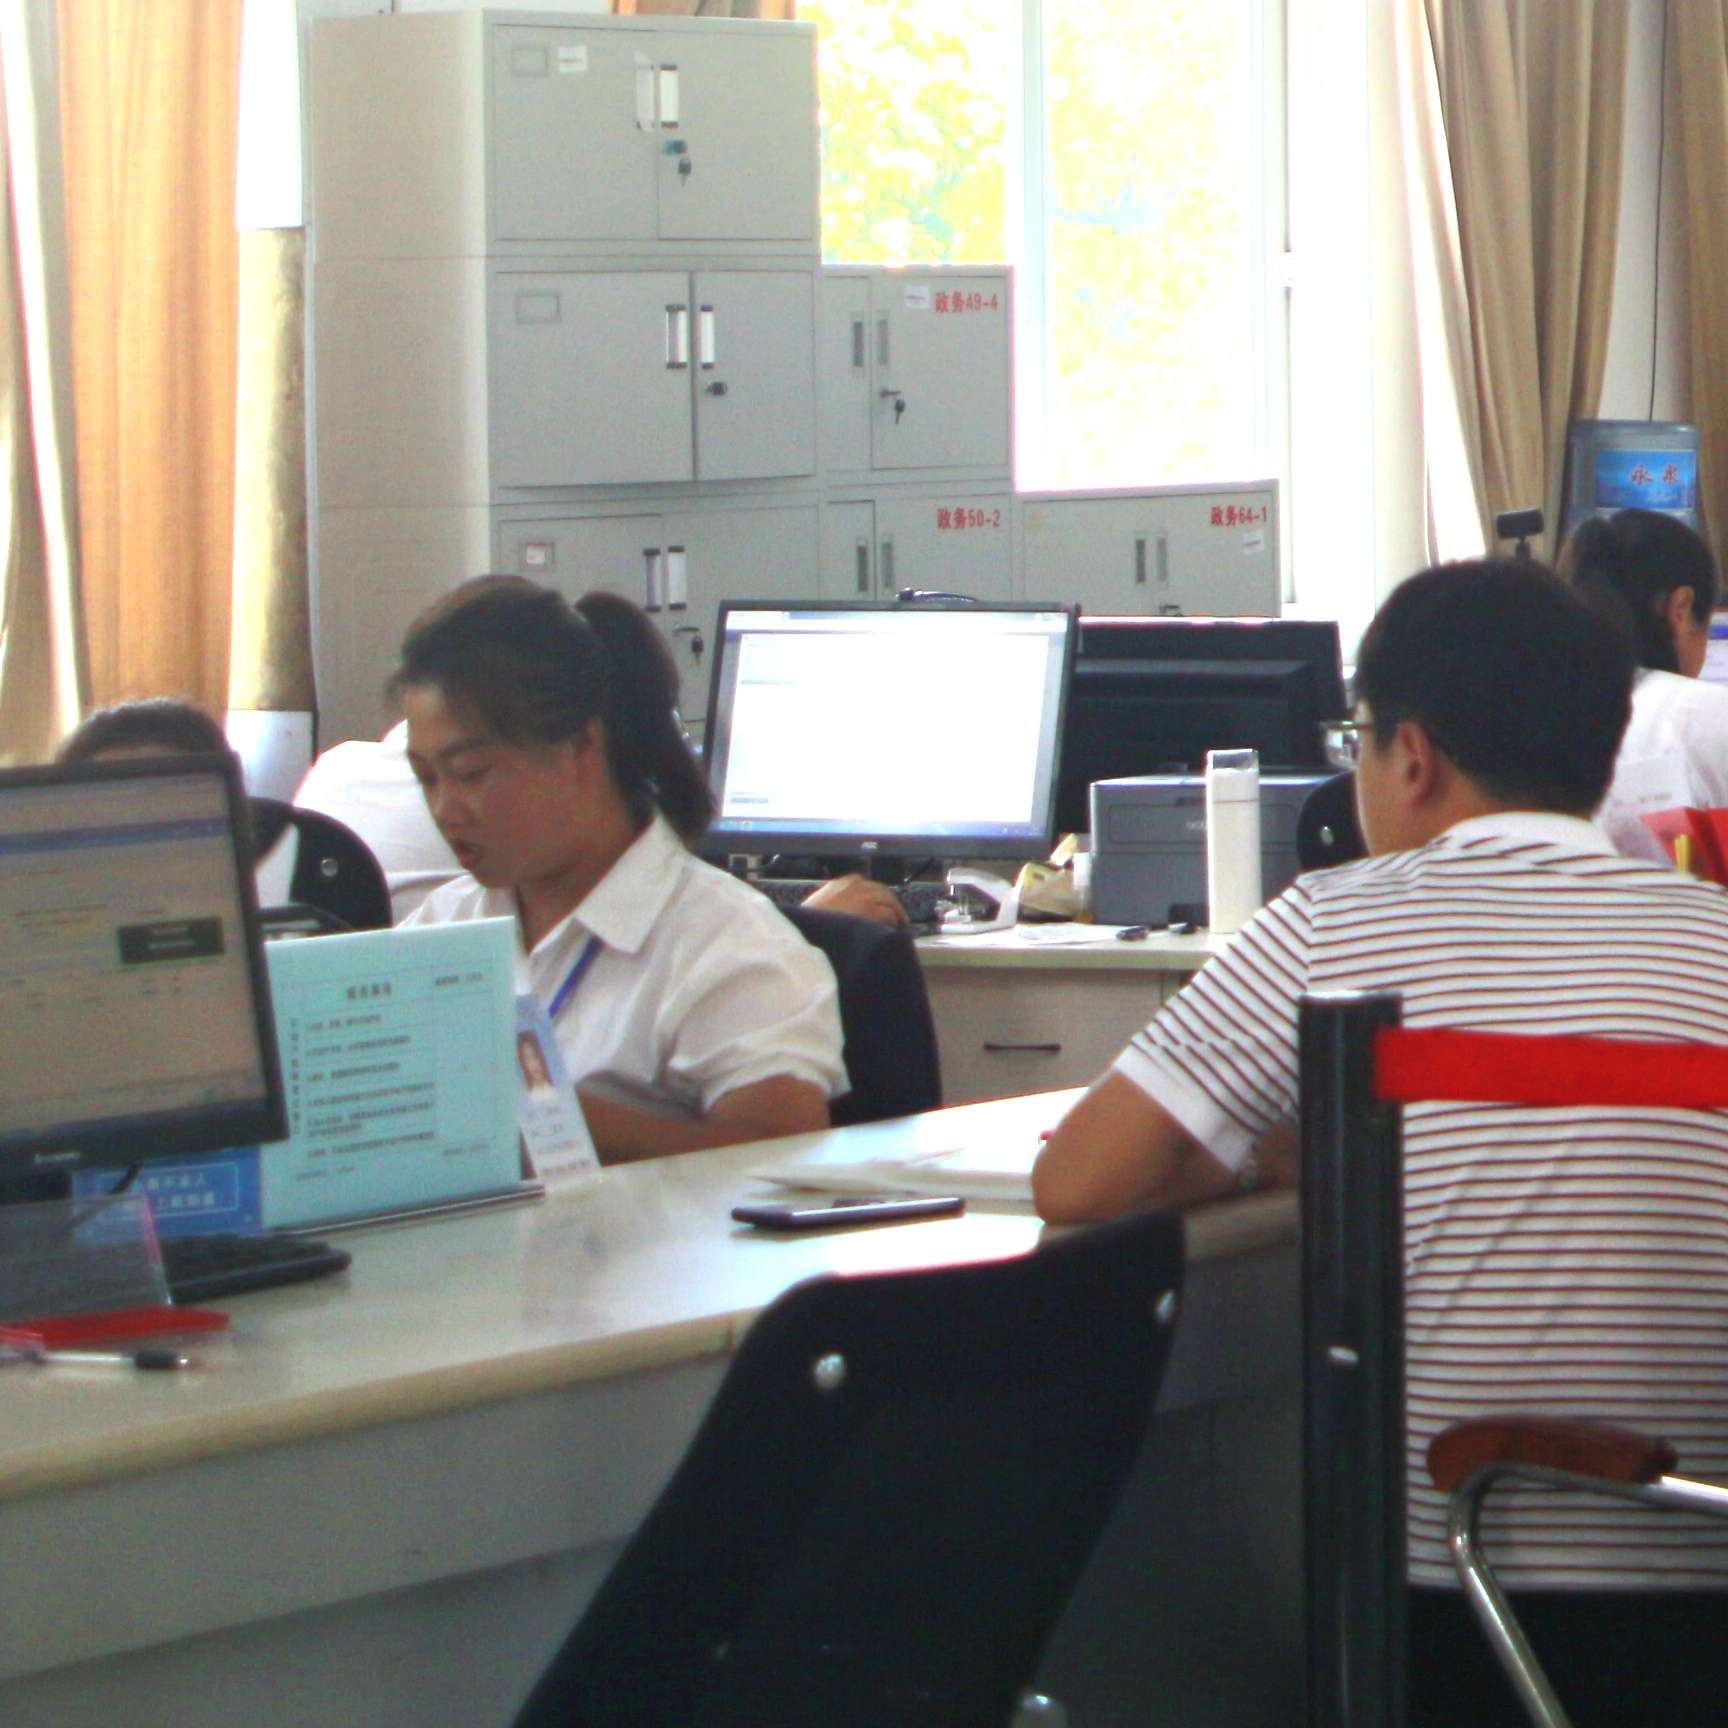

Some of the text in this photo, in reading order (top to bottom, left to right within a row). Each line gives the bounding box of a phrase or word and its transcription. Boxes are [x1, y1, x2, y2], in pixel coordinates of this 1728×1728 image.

[935, 291, 998, 314] 政务49-4
[937, 507, 1002, 530] 政务50-2
[1210, 505, 1269, 527] 政务64-1
